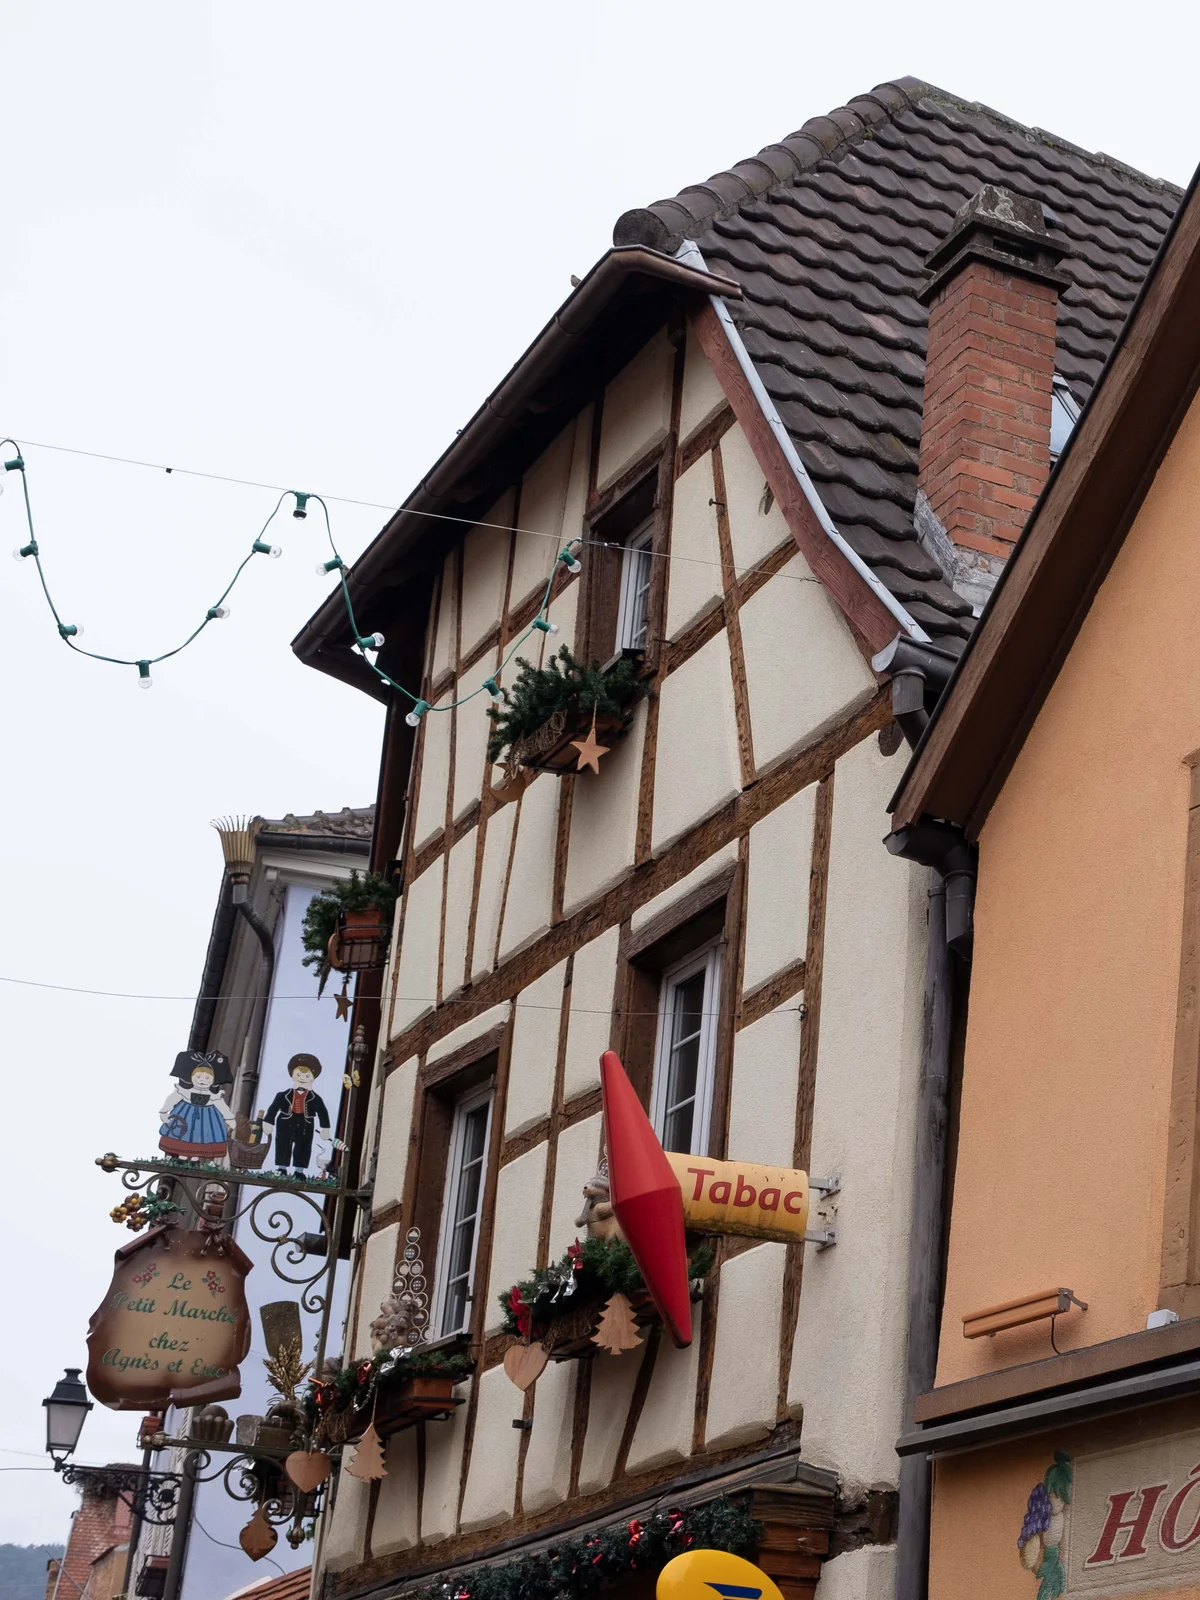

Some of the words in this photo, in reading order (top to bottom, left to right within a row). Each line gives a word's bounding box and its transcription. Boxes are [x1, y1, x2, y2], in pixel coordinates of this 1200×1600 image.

[687, 1167, 803, 1215] Tabac
[167, 1272, 192, 1291] Le
[110, 1292, 156, 1314] Petit
[163, 1299, 238, 1325] Marché
[148, 1331, 190, 1352] chez
[102, 1348, 159, 1373] Agnès
[167, 1358, 183, 1374] et
